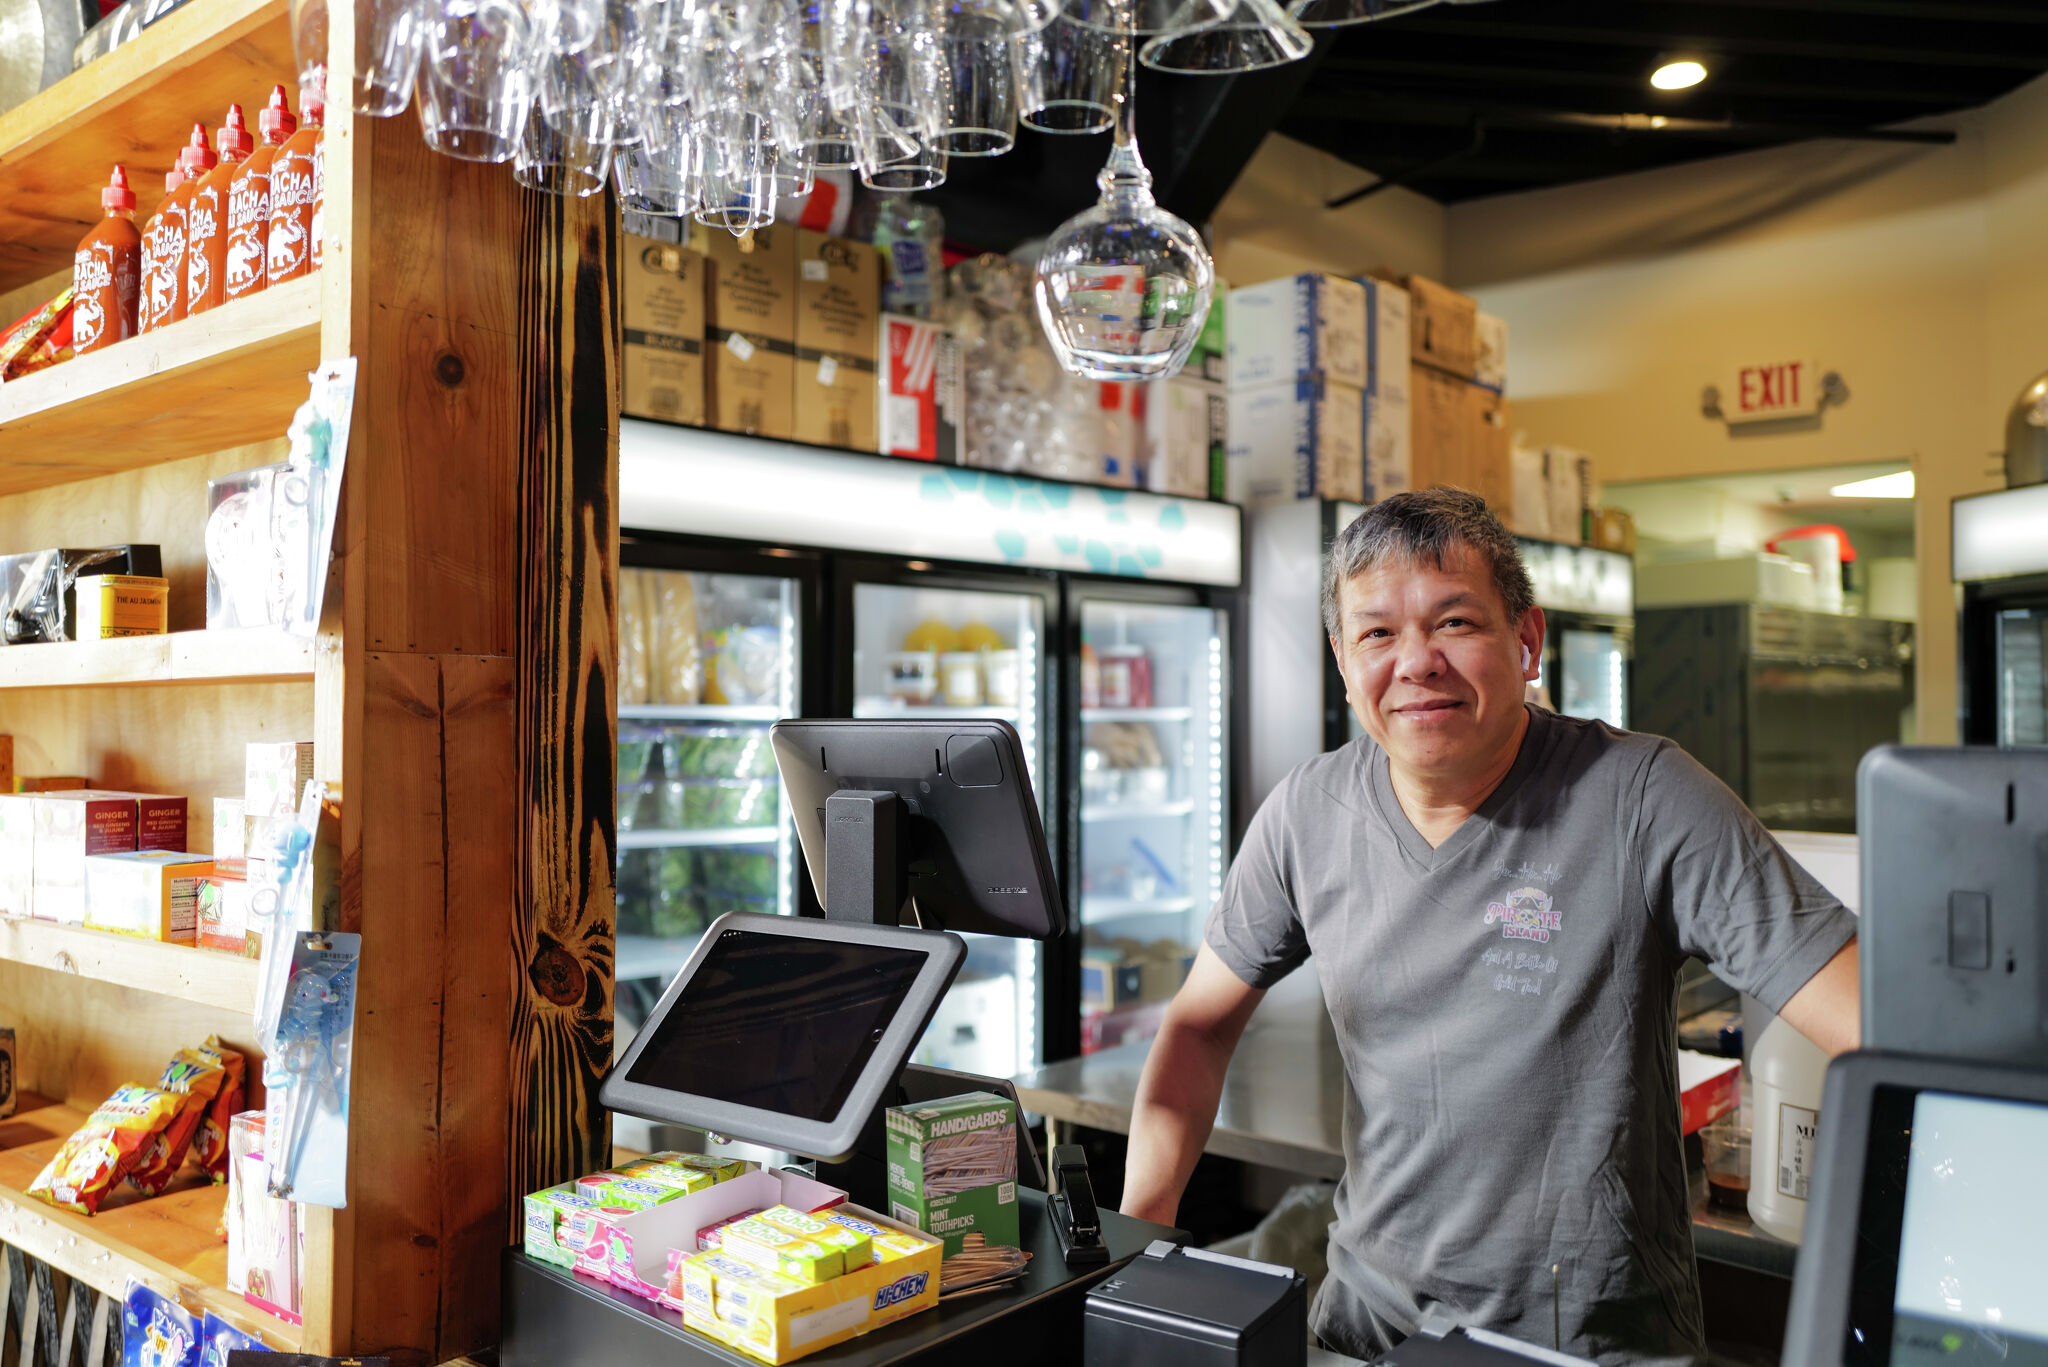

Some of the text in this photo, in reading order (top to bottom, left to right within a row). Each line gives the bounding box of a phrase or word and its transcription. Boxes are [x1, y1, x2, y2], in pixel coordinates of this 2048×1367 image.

[1740, 361, 1803, 412] EXIT
[95, 811, 129, 820] GINGER
[149, 809, 181, 818] GINGER
[1503, 924, 1549, 943] ISLAND
[1000, 1184, 1013, 1194] 1000
[1000, 1193, 1014, 1203] COUNT
[930, 1208, 950, 1223] MINT
[930, 1214, 975, 1234] TOOTHPICKS
[828, 1214, 889, 1236] HI-CHEW
[873, 1271, 930, 1311] HI-CHEW
